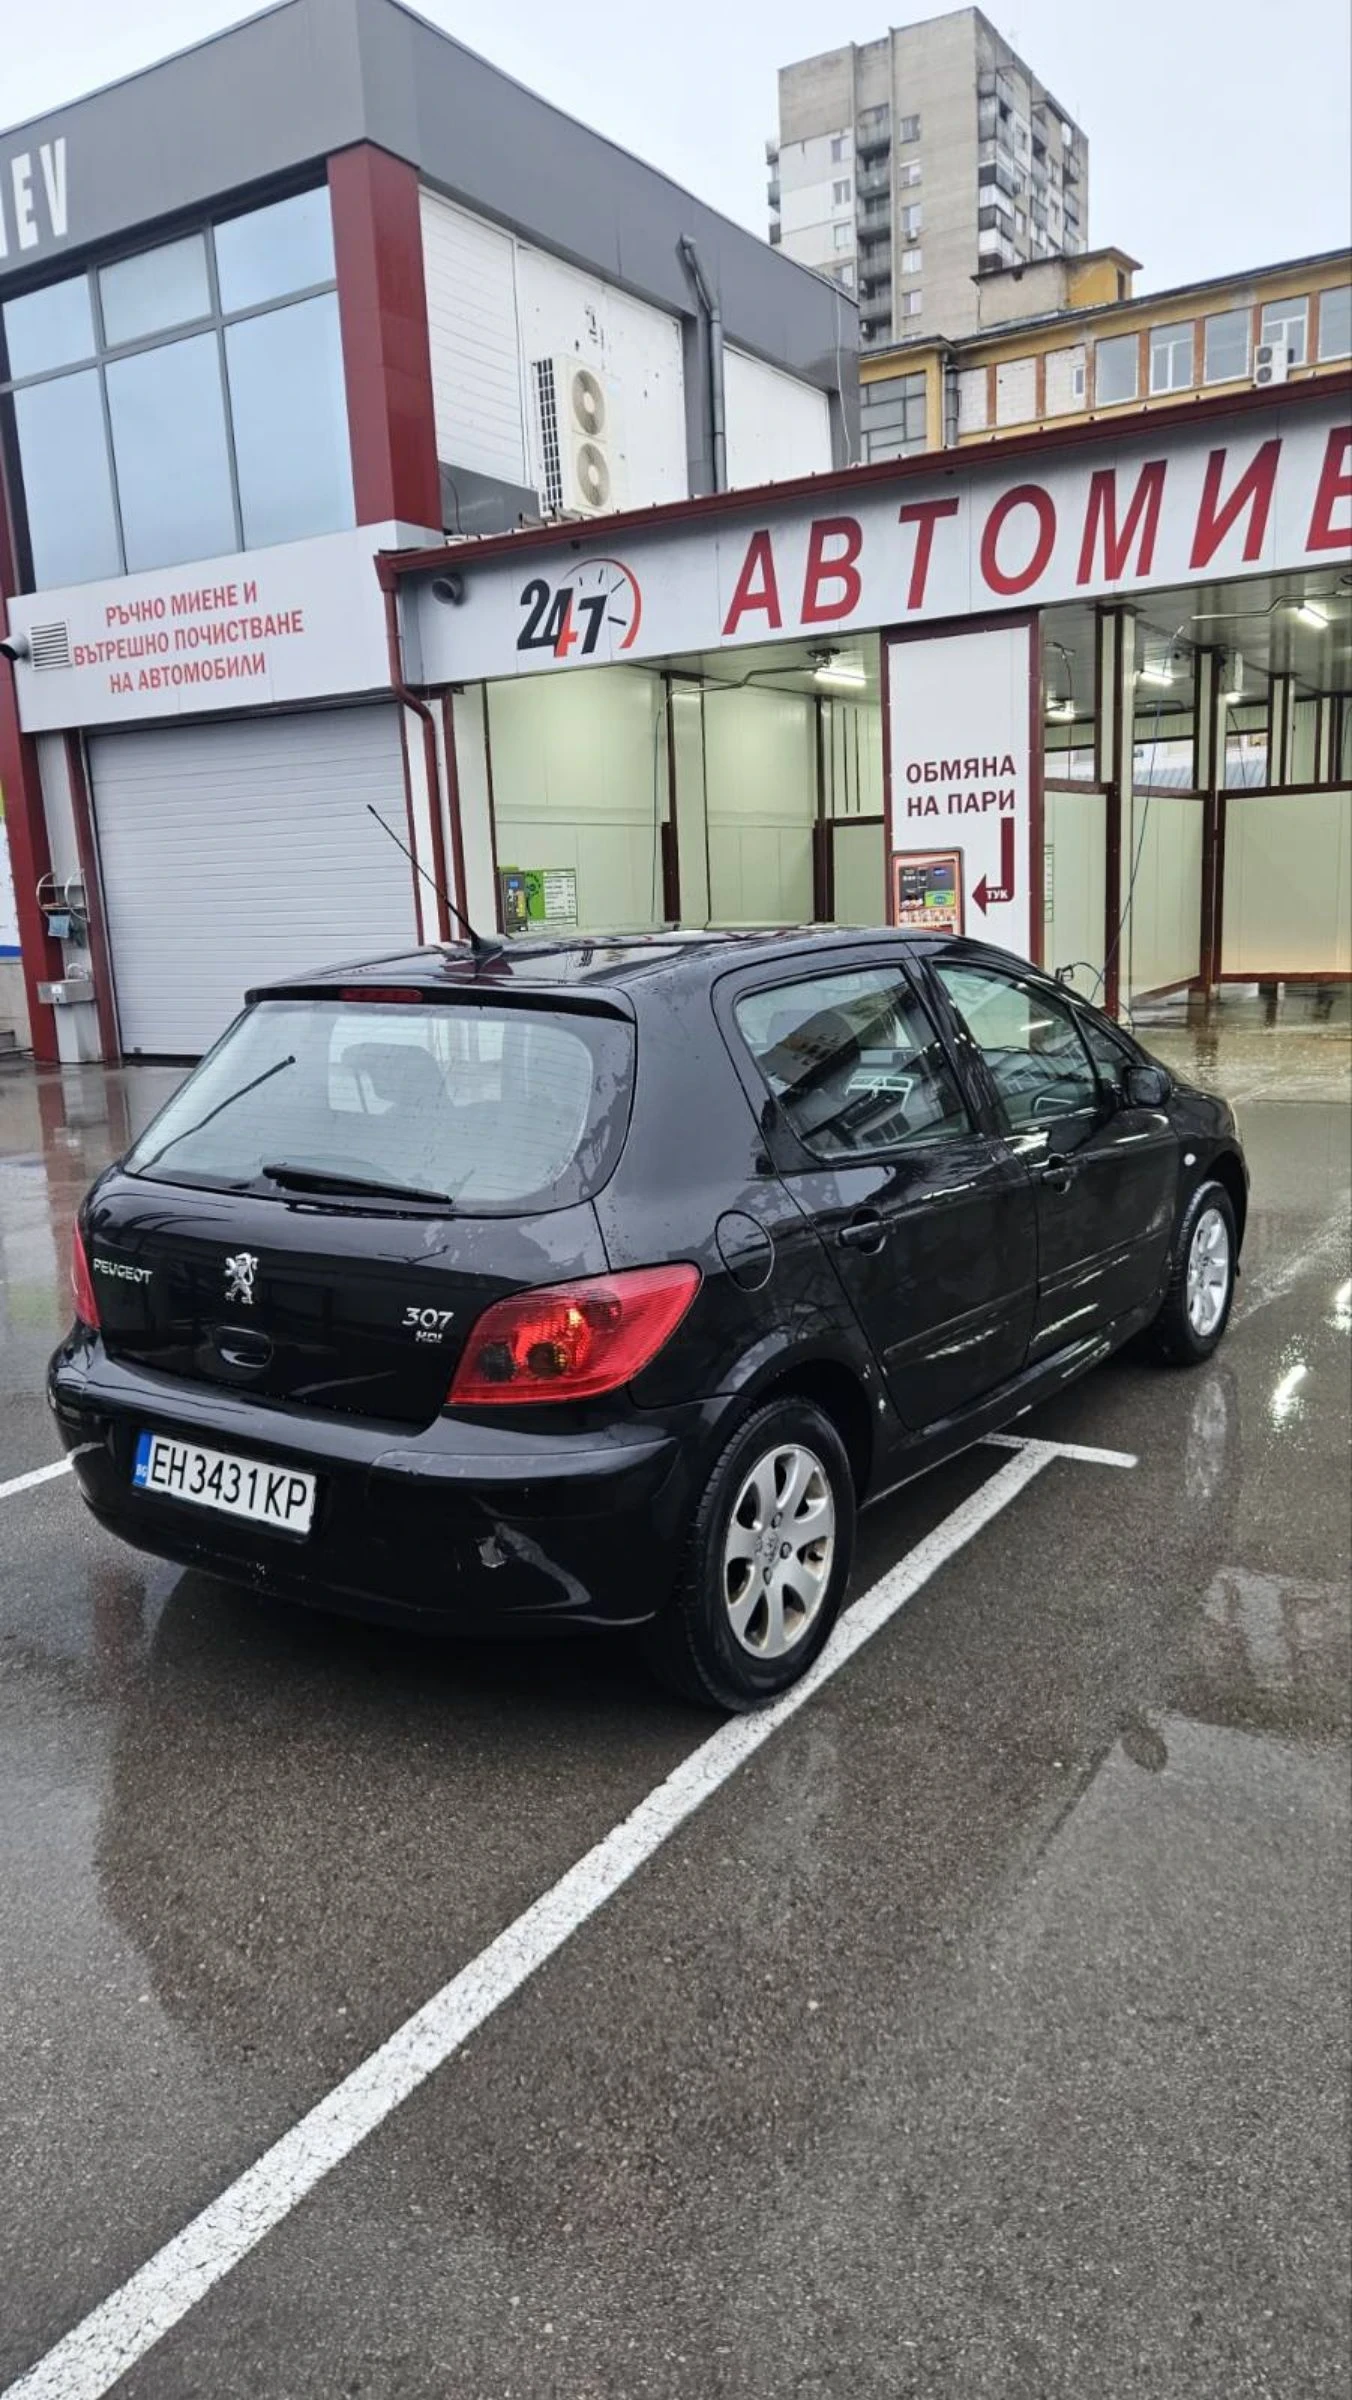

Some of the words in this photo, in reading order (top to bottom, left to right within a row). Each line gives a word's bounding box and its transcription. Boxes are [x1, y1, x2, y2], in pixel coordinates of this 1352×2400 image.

[0, 137, 67, 257] EV
[106, 597, 165, 627] РЪЧНО
[171, 584, 238, 616] МИЕНЕ
[244, 580, 258, 604] И
[73, 631, 169, 666] ВЪТРЕШНО
[175, 609, 304, 650] ПОЧИСТВАНЕ
[110, 671, 133, 694] НА
[139, 651, 265, 690] АВТОМОБИЛИ
[906, 755, 1016, 784] ОБМЯНА
[907, 795, 939, 817] НА
[948, 789, 1015, 815] ПАРИ
[984, 889, 1009, 900] ТУК
[93, 1258, 153, 1284] PEUGEOT
[402, 1307, 454, 1330] 307
